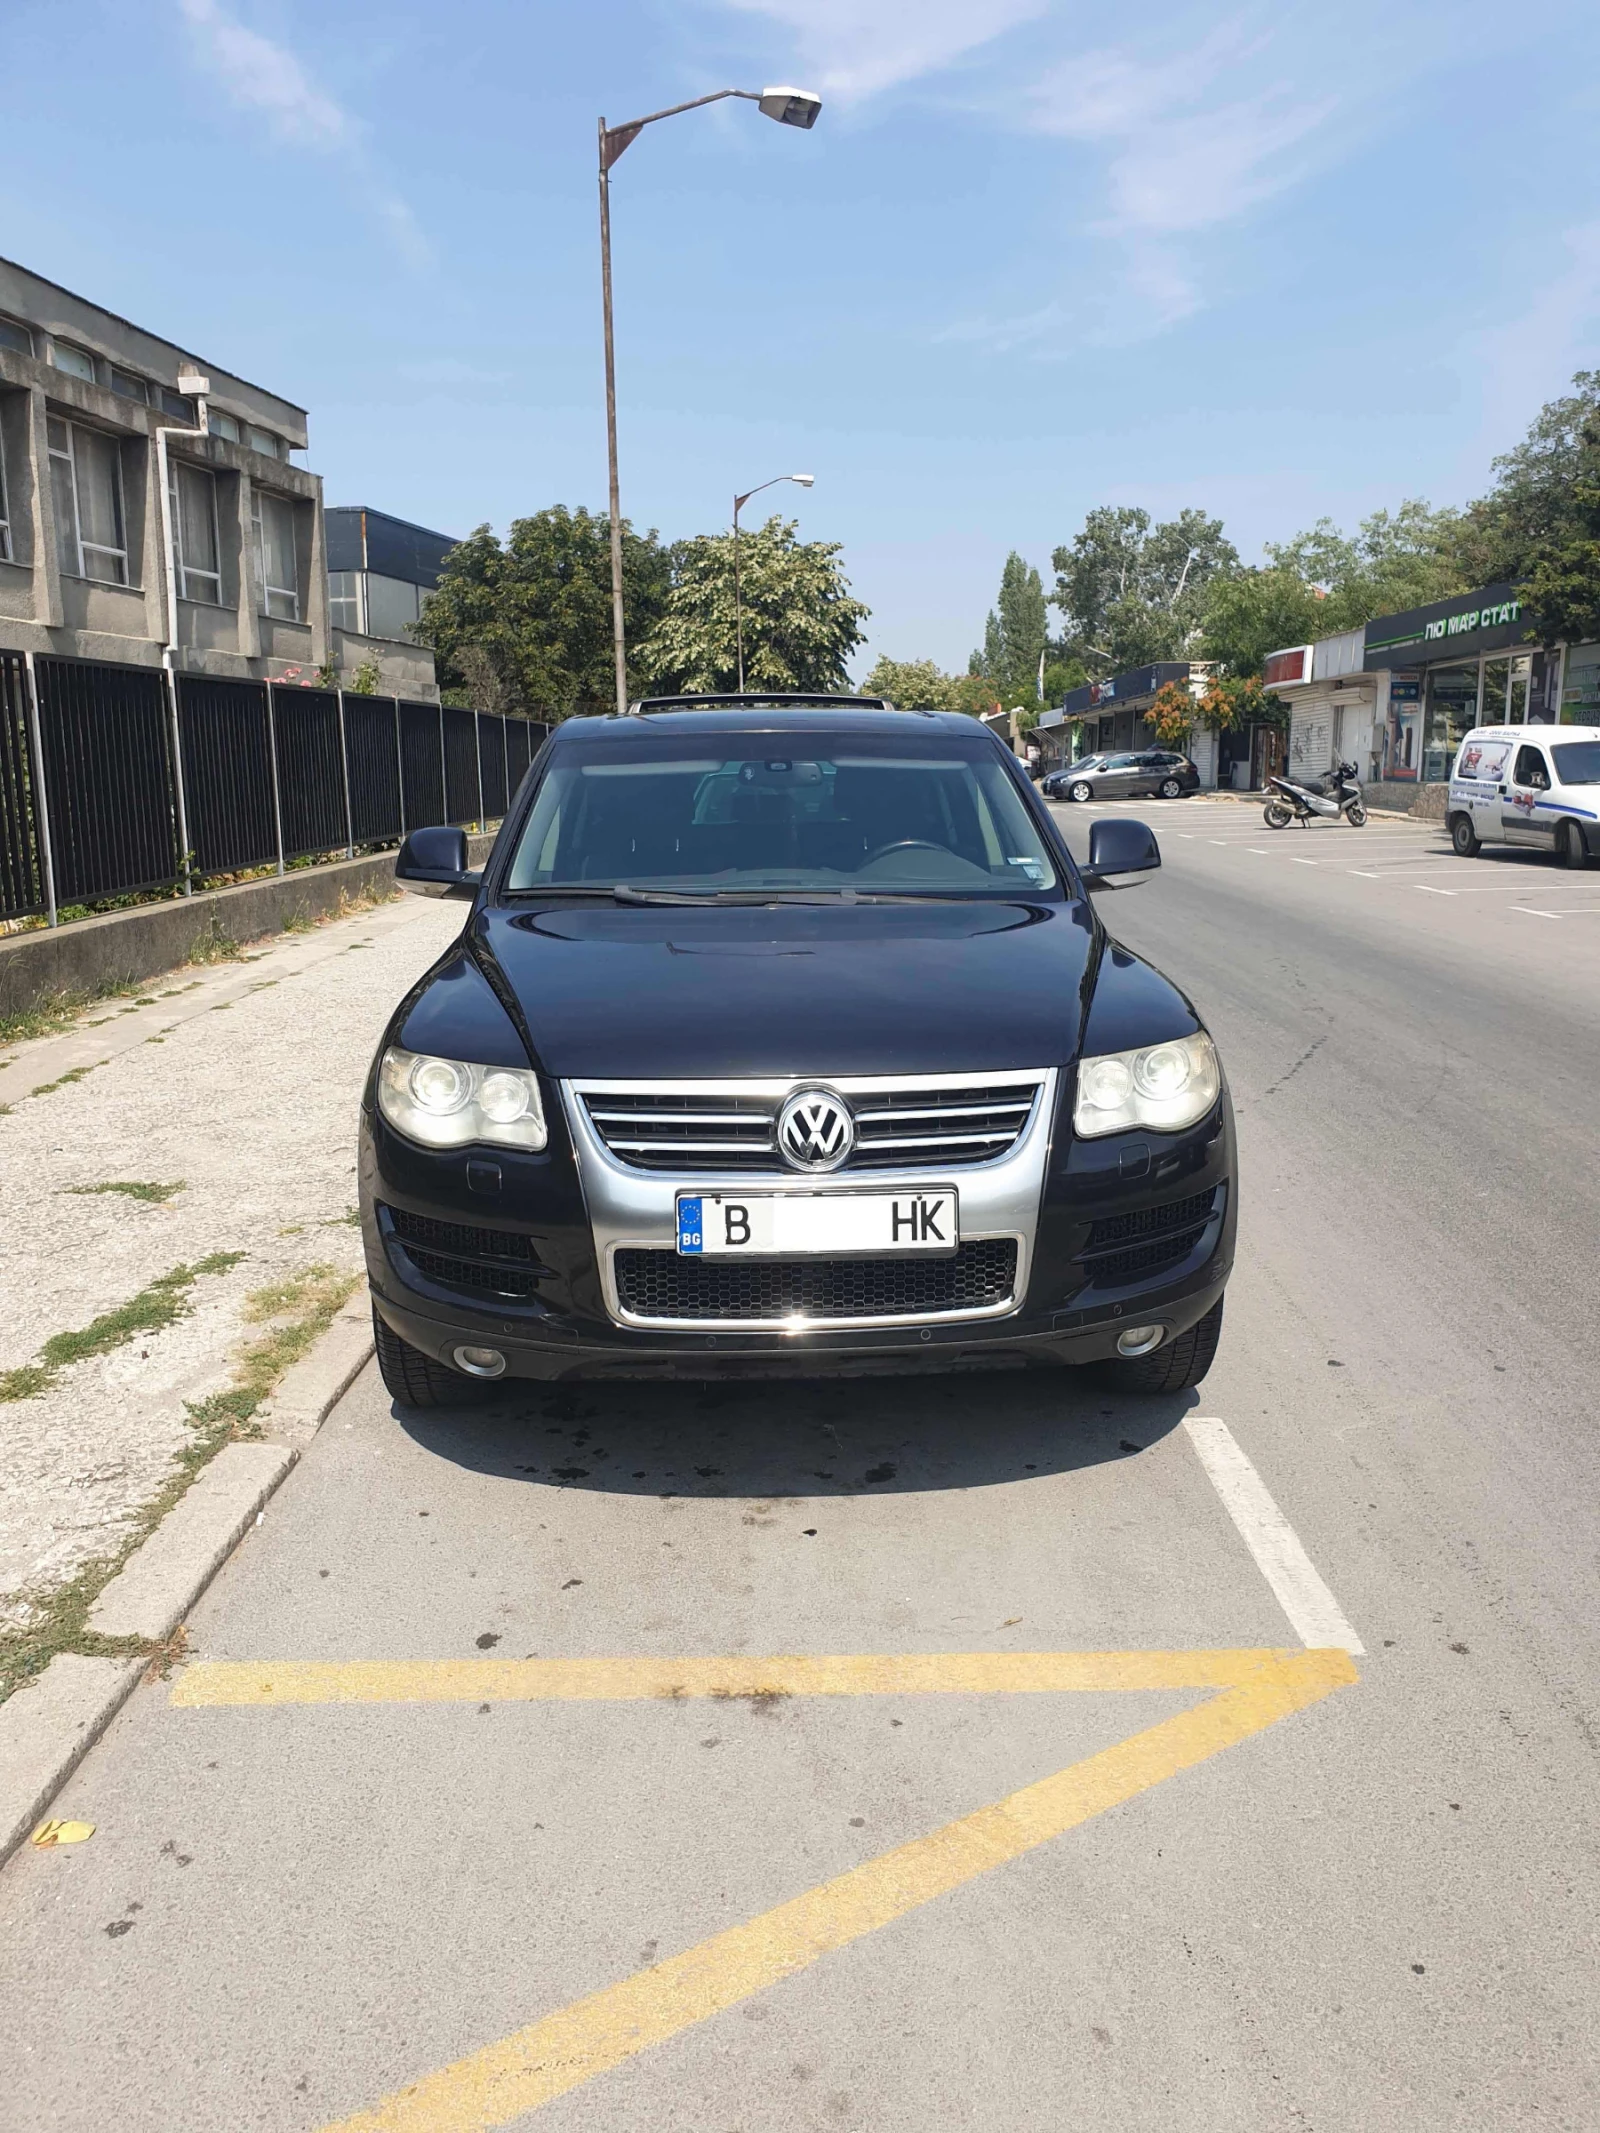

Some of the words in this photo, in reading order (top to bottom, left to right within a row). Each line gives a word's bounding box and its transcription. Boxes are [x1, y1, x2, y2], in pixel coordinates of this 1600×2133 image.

[1449, 611, 1481, 636] МАР
[1481, 601, 1521, 628] СТАТ
[782, 1094, 848, 1163] VW
[682, 1233, 701, 1245] BG
[725, 1204, 751, 1245] B
